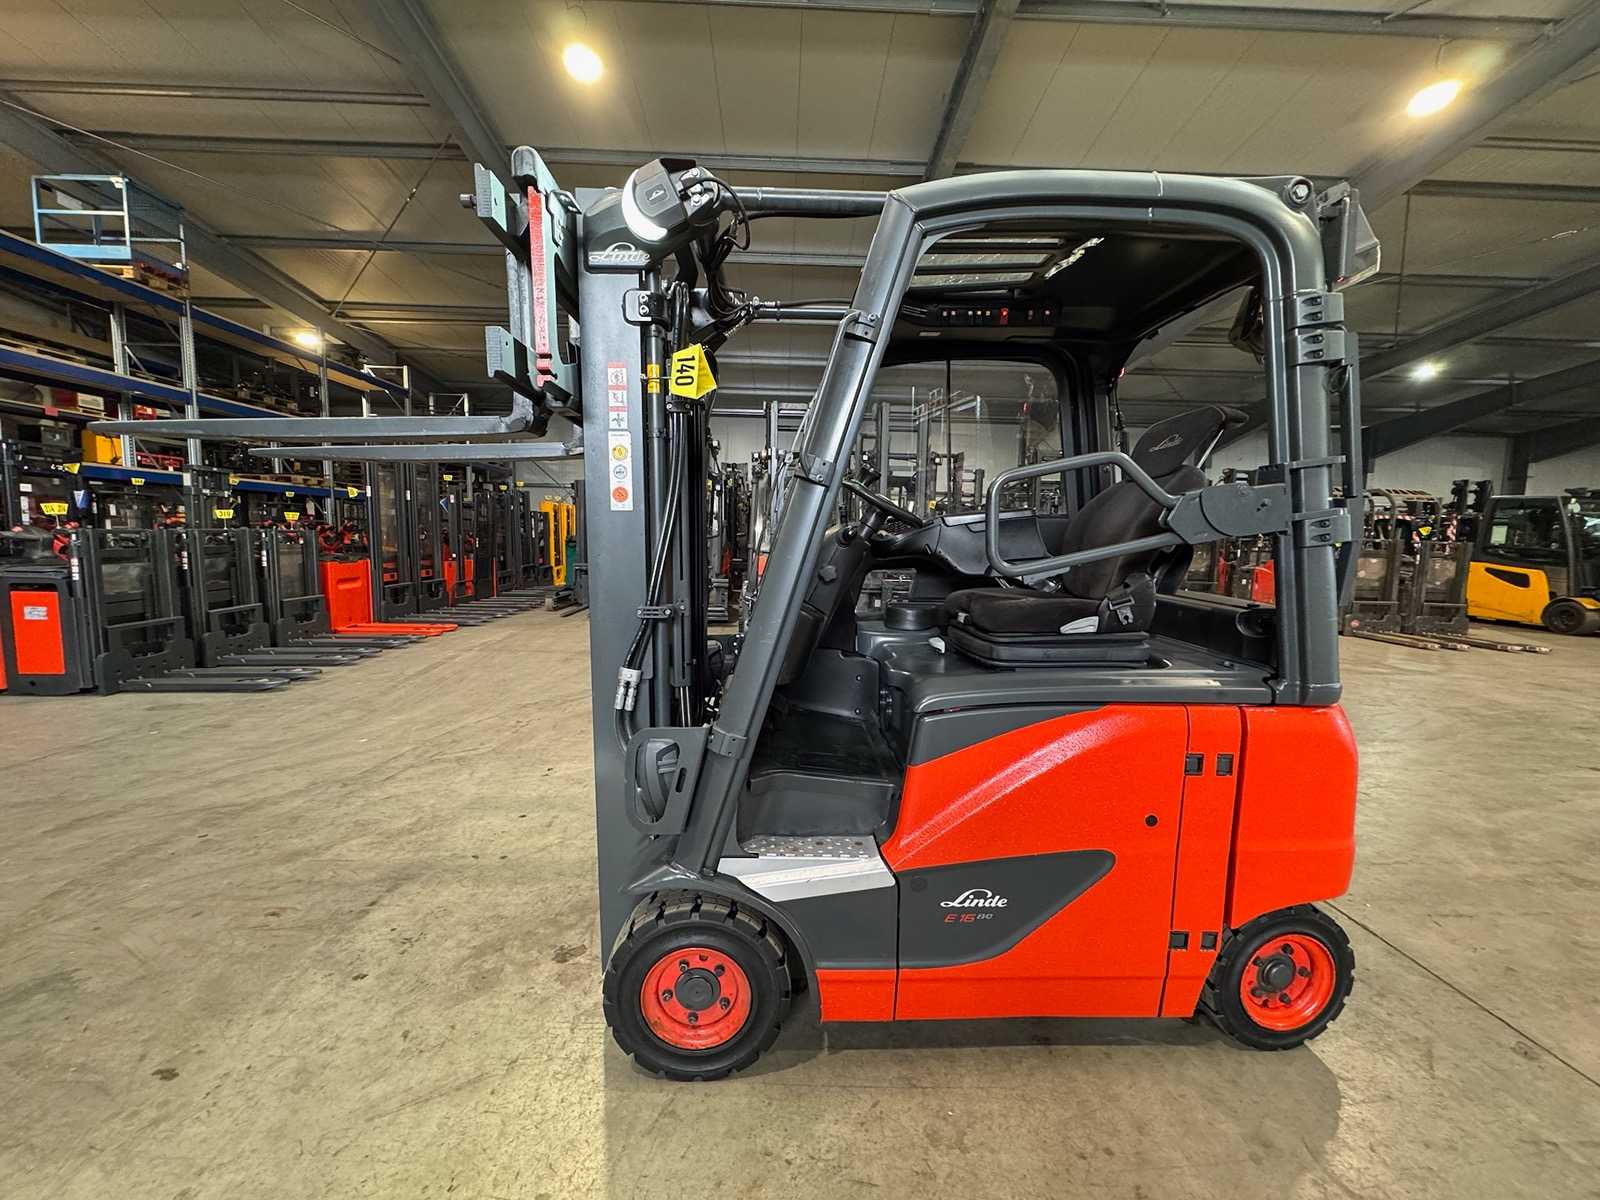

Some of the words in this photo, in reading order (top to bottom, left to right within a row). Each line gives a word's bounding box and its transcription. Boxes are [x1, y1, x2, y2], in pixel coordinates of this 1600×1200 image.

[589, 242, 651, 264] Linde
[675, 355, 695, 387] 140
[940, 888, 1008, 908] Linde
[944, 913, 958, 923] E
[960, 913, 977, 923] 16
